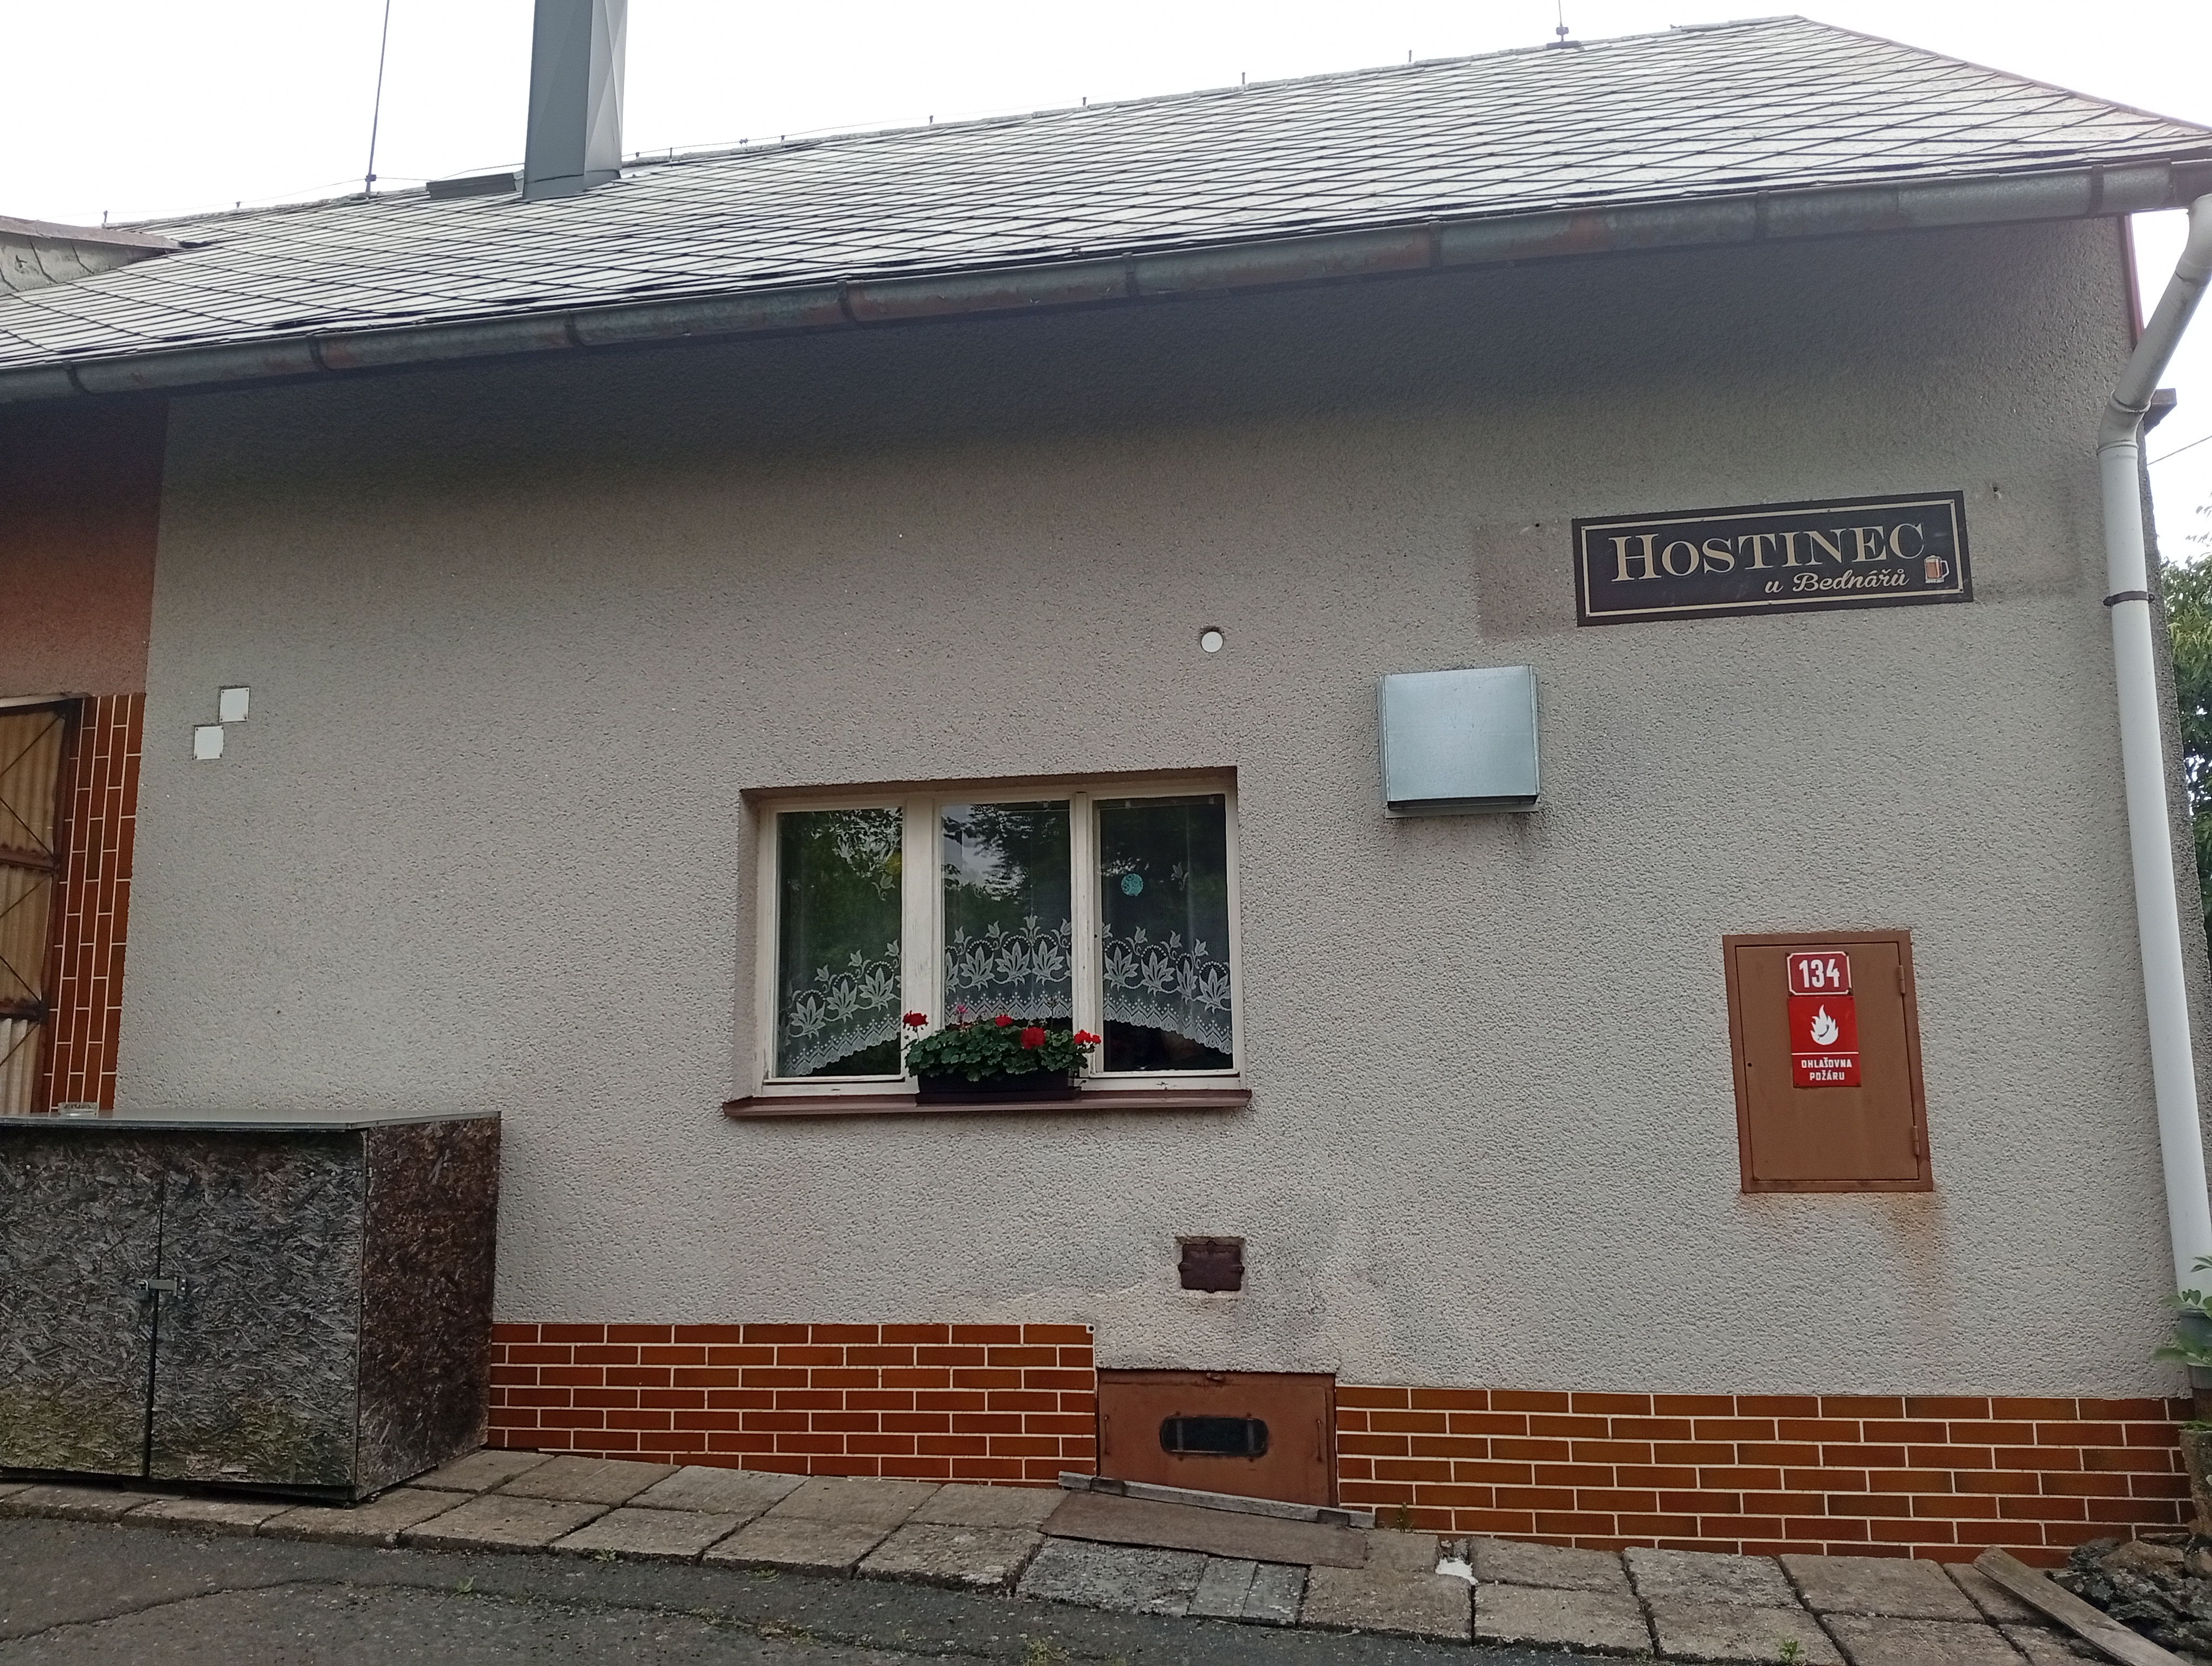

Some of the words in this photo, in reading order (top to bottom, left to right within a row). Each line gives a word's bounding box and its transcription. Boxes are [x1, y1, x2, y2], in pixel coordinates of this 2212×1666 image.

[1608, 523, 1925, 582] HOSTINEC
[1765, 580, 1784, 594] u
[1792, 567, 1909, 592] Bednářů
[1799, 958, 1840, 988] 134
[1801, 1056, 1853, 1068] OHLAŠOVNA
[1809, 1069, 1845, 1081] POŽÁRU
